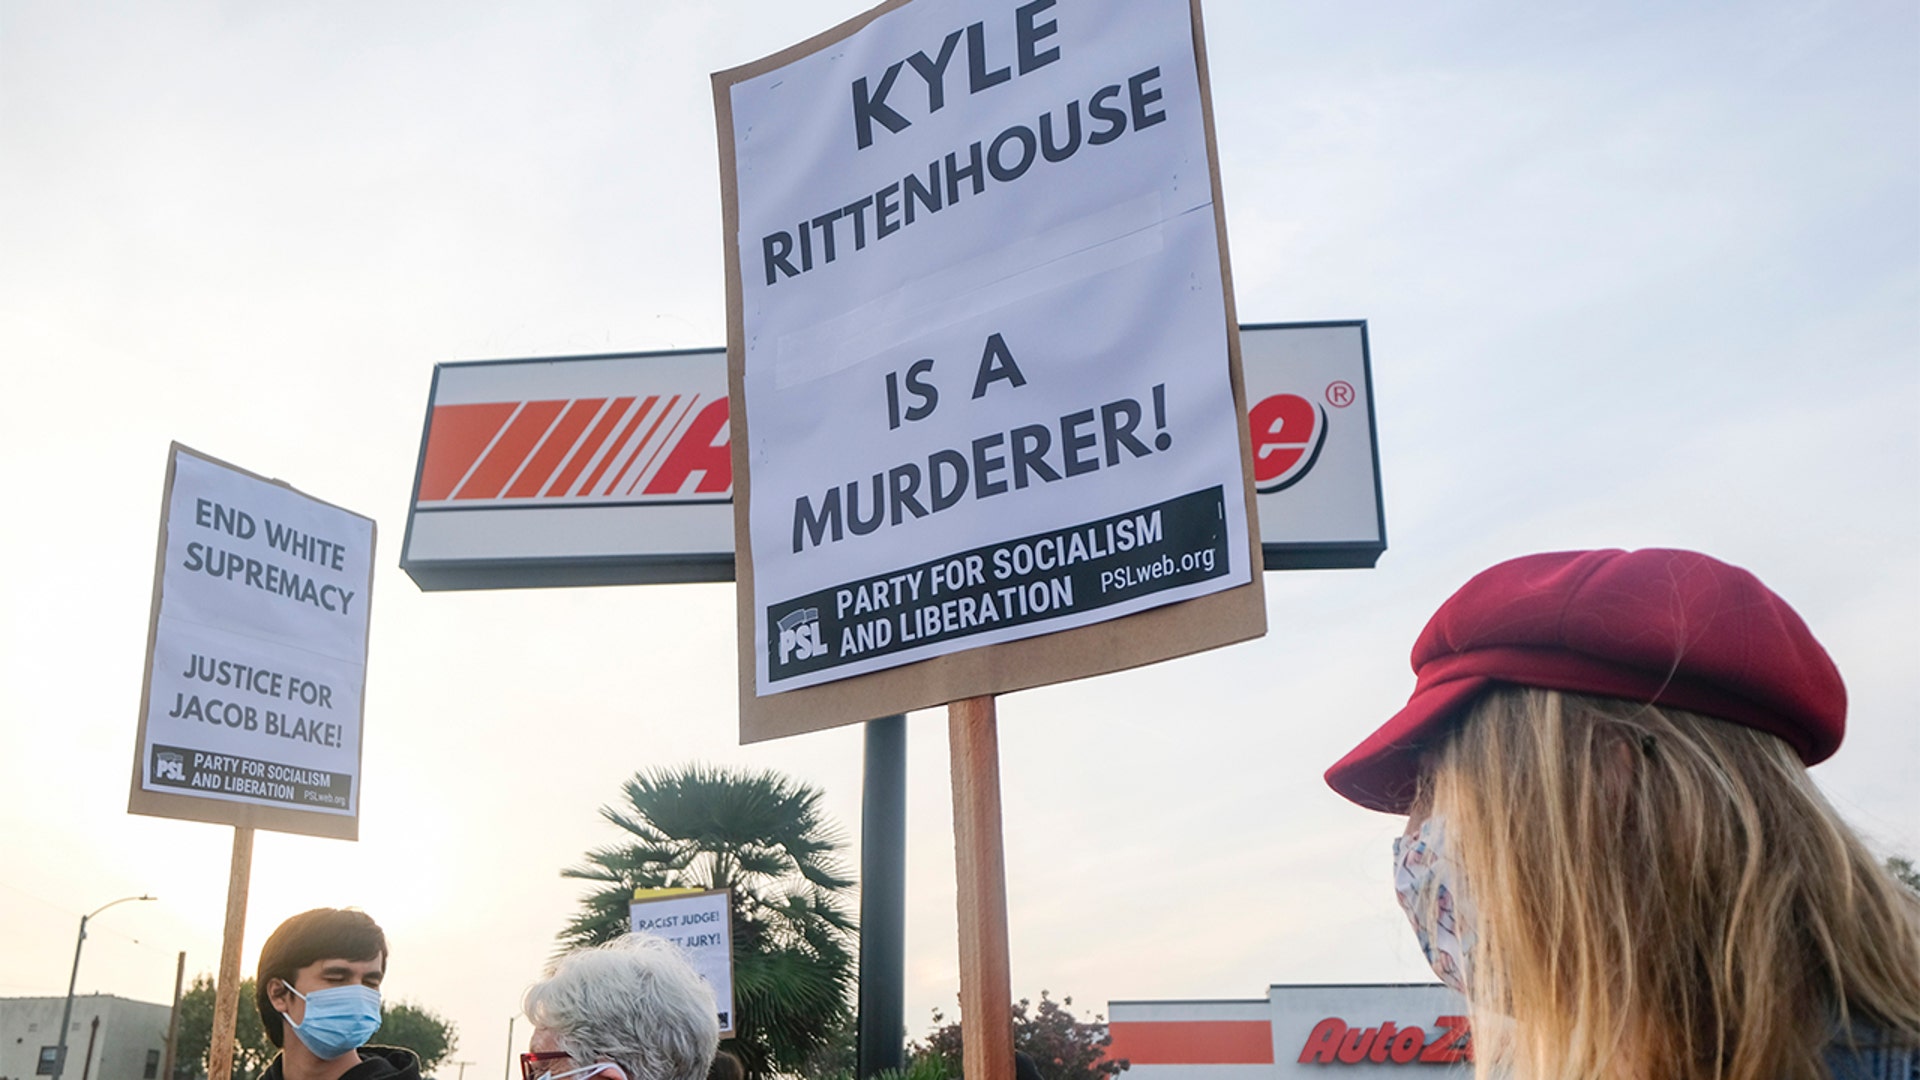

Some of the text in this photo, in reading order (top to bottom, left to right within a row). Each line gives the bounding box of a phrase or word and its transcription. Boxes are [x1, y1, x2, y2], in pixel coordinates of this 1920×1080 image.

[851, 0, 1061, 150] KYLE
[762, 65, 1167, 286] RITTENHOUSE
[885, 332, 1027, 431] IS A
[792, 383, 1172, 554] MURDERER!
[195, 497, 346, 572] END WHITE
[183, 542, 355, 615] SUPREMACY
[836, 510, 1163, 619] PARTY FOR SOCIALISM
[1101, 548, 1216, 594] PSLweb.org
[778, 621, 828, 665] PSL
[840, 575, 1074, 659] AND LIBERATION
[183, 654, 333, 708] JUSTICE FOR
[169, 692, 343, 748] JACOB BLAKE!
[156, 759, 186, 781] PSL
[191, 772, 295, 800] AND LIBERATION
[193, 753, 331, 788] PARTY FOR SOCIALISM
[303, 790, 346, 807] PSLweb.org
[639, 911, 720, 930] RACIST JUDGE!
[686, 933, 721, 947] JURY!
[1297, 1015, 1475, 1064] AutoZ
